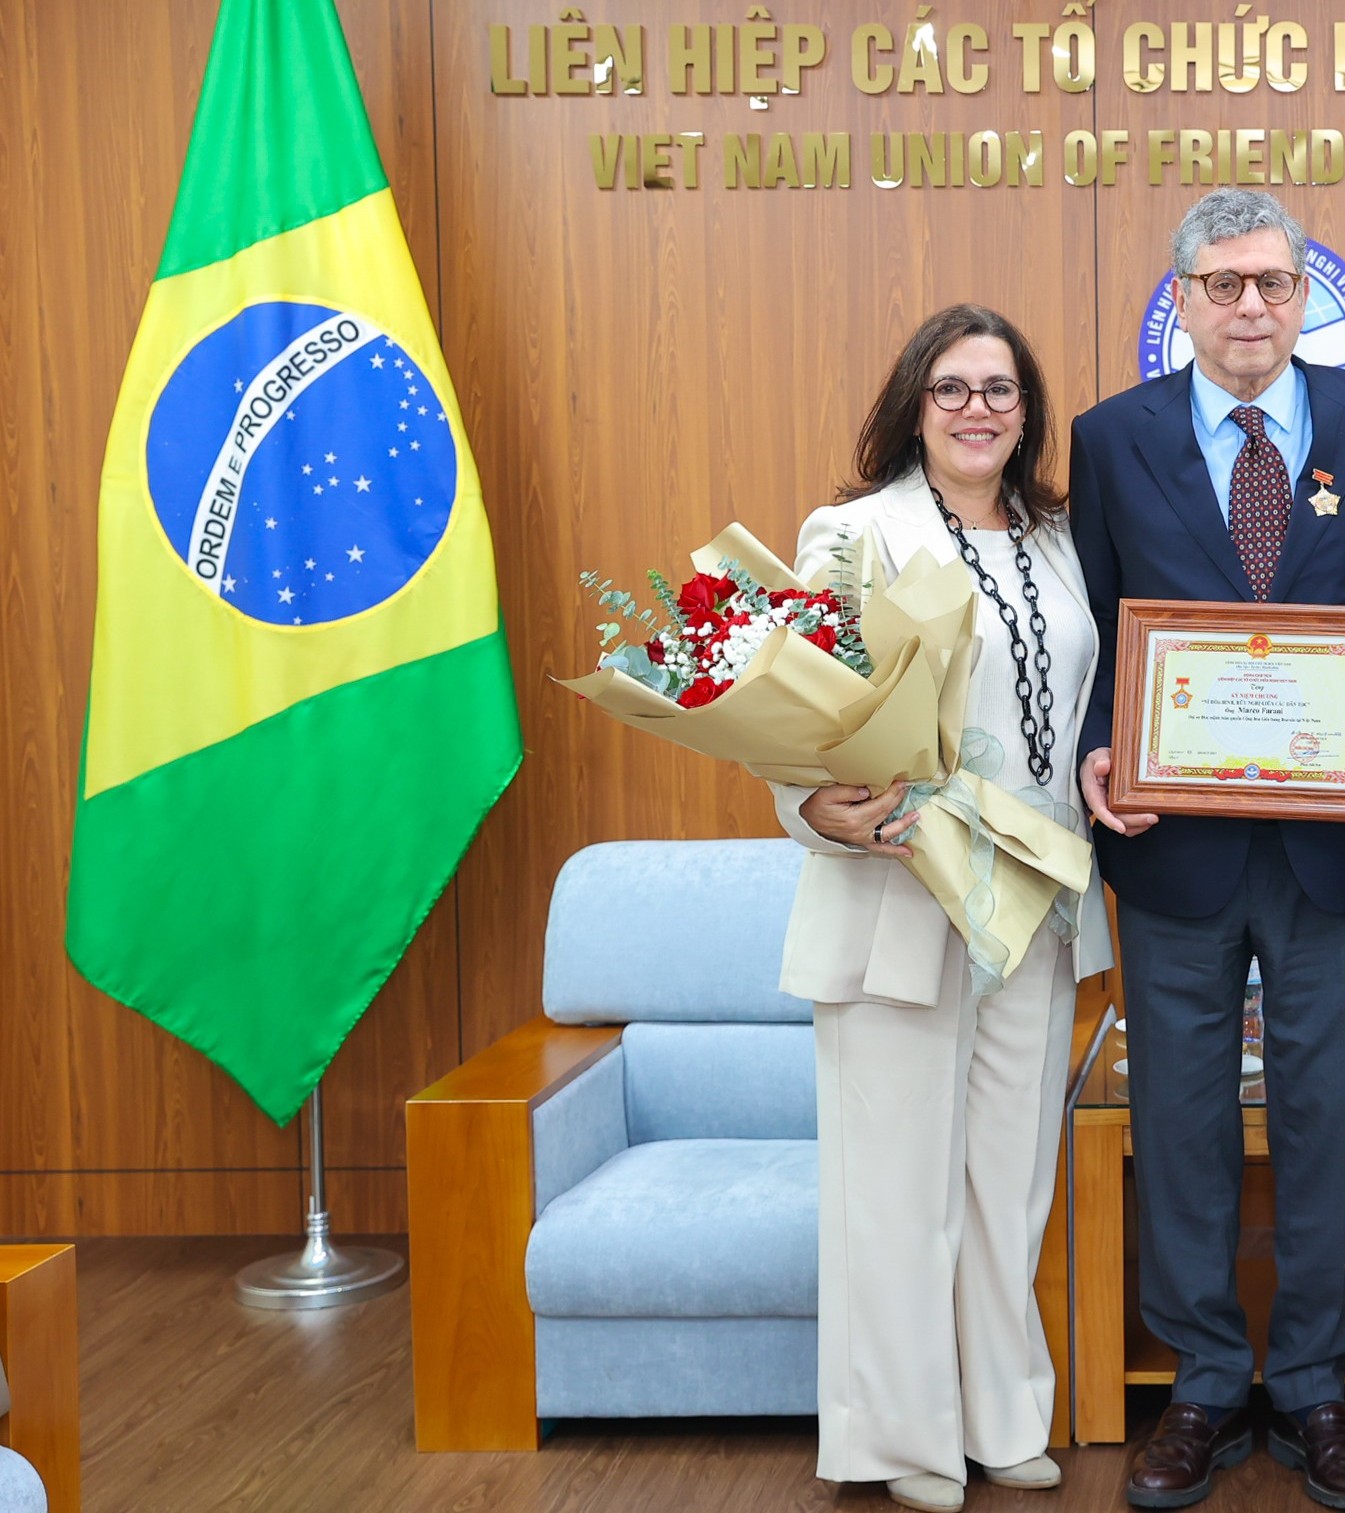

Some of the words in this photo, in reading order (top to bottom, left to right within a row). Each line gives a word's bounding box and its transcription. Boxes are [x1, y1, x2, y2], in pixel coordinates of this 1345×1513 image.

[490, 8, 644, 95] LIÊN
[669, 5, 826, 111] HIỆP
[851, 6, 990, 95] CÁC
[1122, 4, 1309, 95] CHỨC
[589, 130, 704, 189] VIET
[722, 130, 852, 189] NAM
[870, 130, 1044, 188] UNION
[1063, 129, 1130, 187] OF
[1306, 248, 1341, 282] NGHỊ
[1146, 309, 1166, 345] LIÊN
[234, 319, 360, 453] PROGRESSO
[227, 456, 243, 475] E
[196, 477, 237, 580] ORDEM
